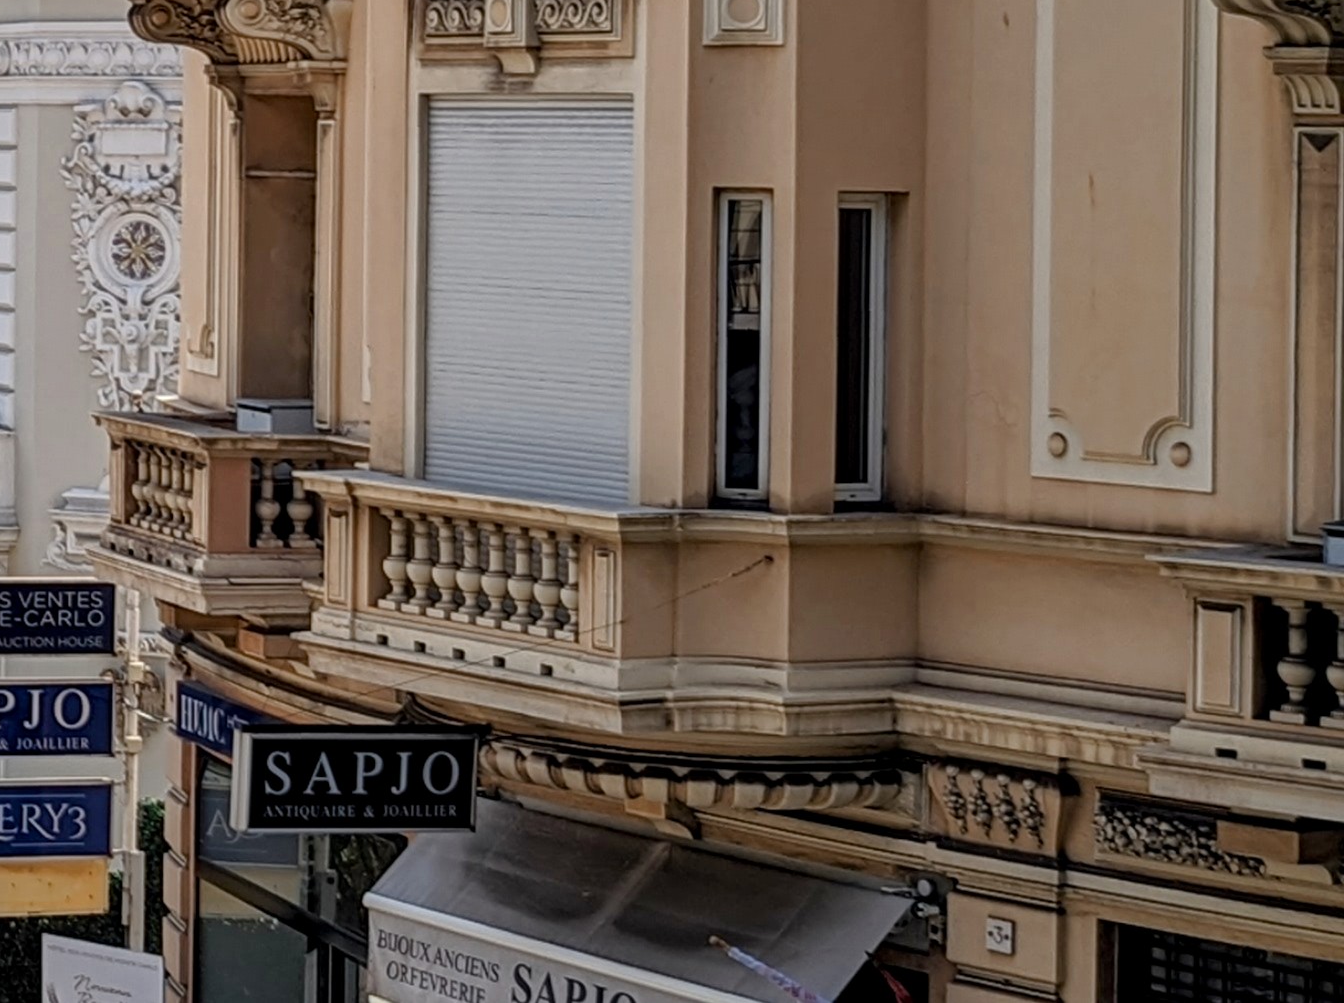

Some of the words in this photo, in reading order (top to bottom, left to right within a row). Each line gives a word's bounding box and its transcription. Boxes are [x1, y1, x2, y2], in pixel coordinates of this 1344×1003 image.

[18, 591, 104, 609] VENTES
[58, 636, 104, 648] HOUSE
[16, 737, 90, 750] JOAILLIER
[264, 751, 460, 795] SAPJO
[263, 805, 356, 820] ANTIQUAIRE
[363, 805, 375, 818] &
[383, 805, 458, 817] JOAILLIER
[376, 929, 433, 964] BIJOUX
[433, 947, 501, 983] ANCIENS
[386, 960, 487, 1003] ORFEVRERIE
[512, 963, 637, 1003] SAP
